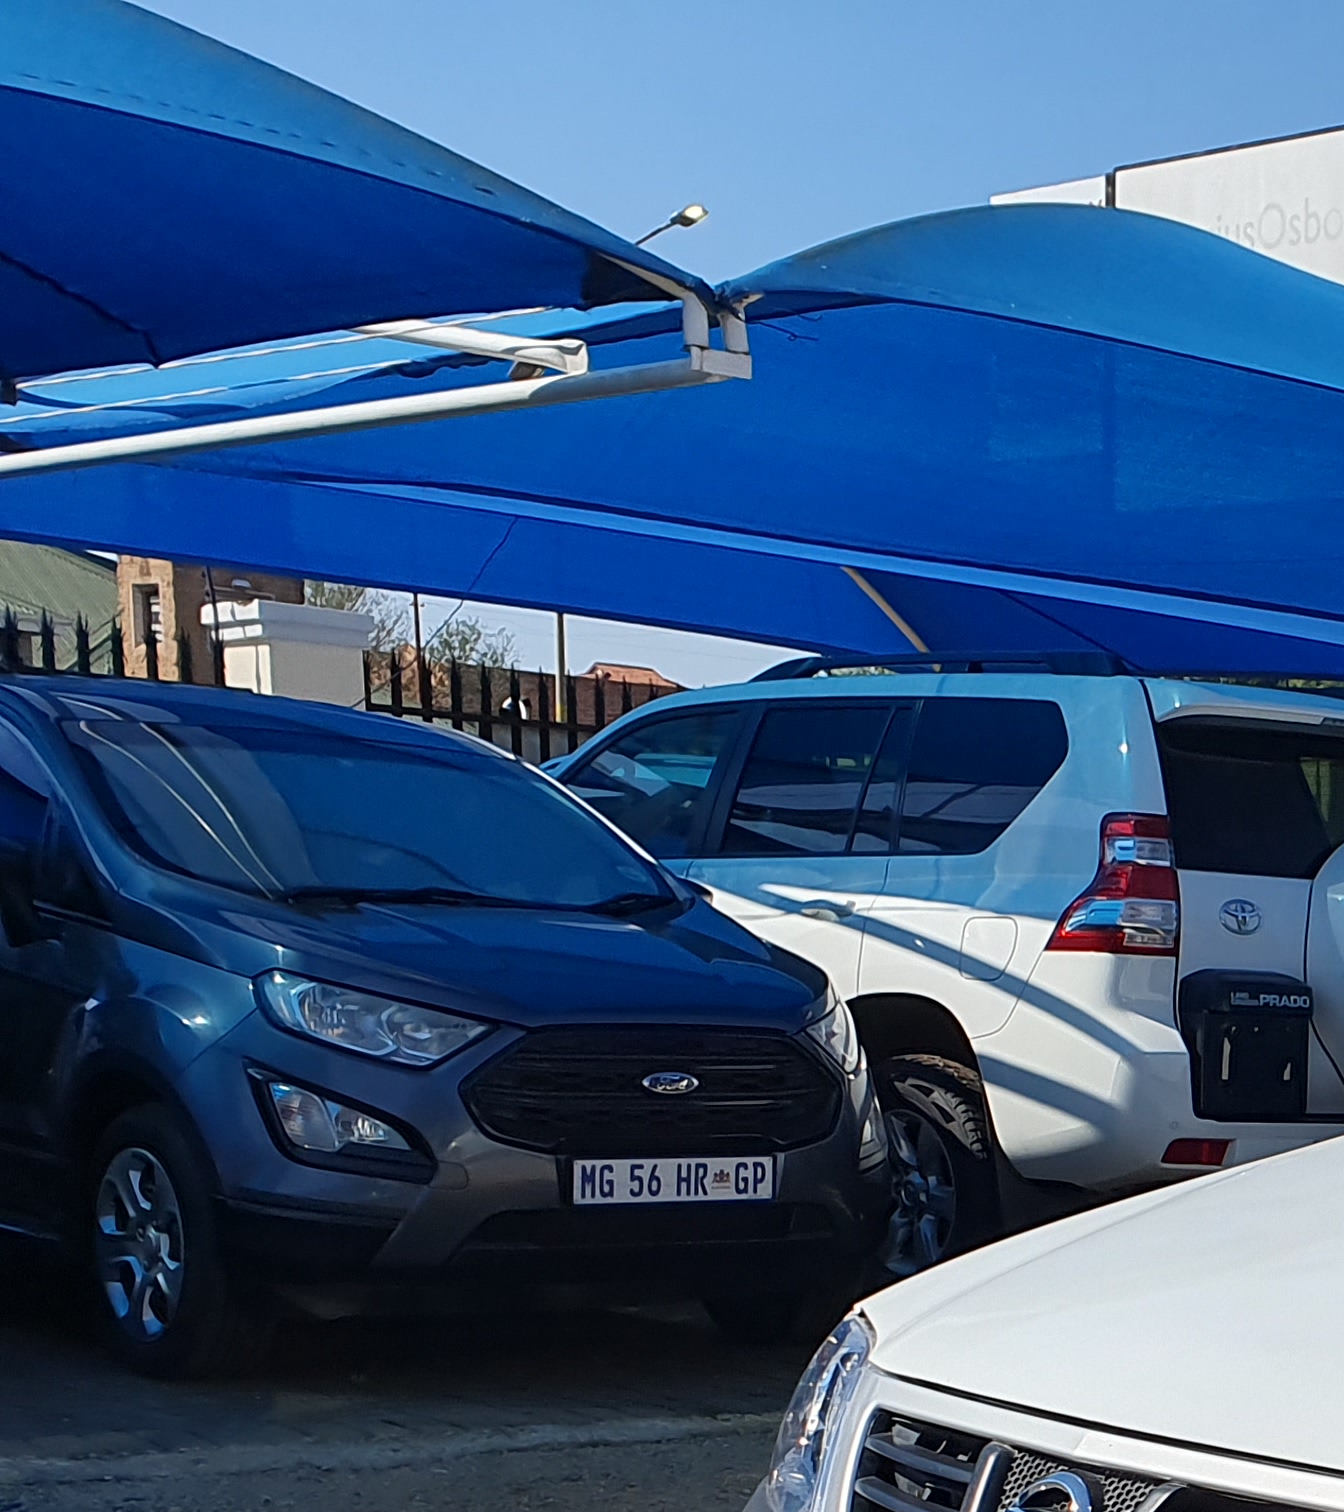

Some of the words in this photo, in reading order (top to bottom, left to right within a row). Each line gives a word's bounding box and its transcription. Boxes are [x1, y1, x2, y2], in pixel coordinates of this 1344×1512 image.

[1259, 994, 1310, 1008] PRADO
[580, 1164, 615, 1199] MG
[629, 1163, 662, 1197] 56
[676, 1162, 708, 1196] HR
[734, 1161, 766, 1195] GP
